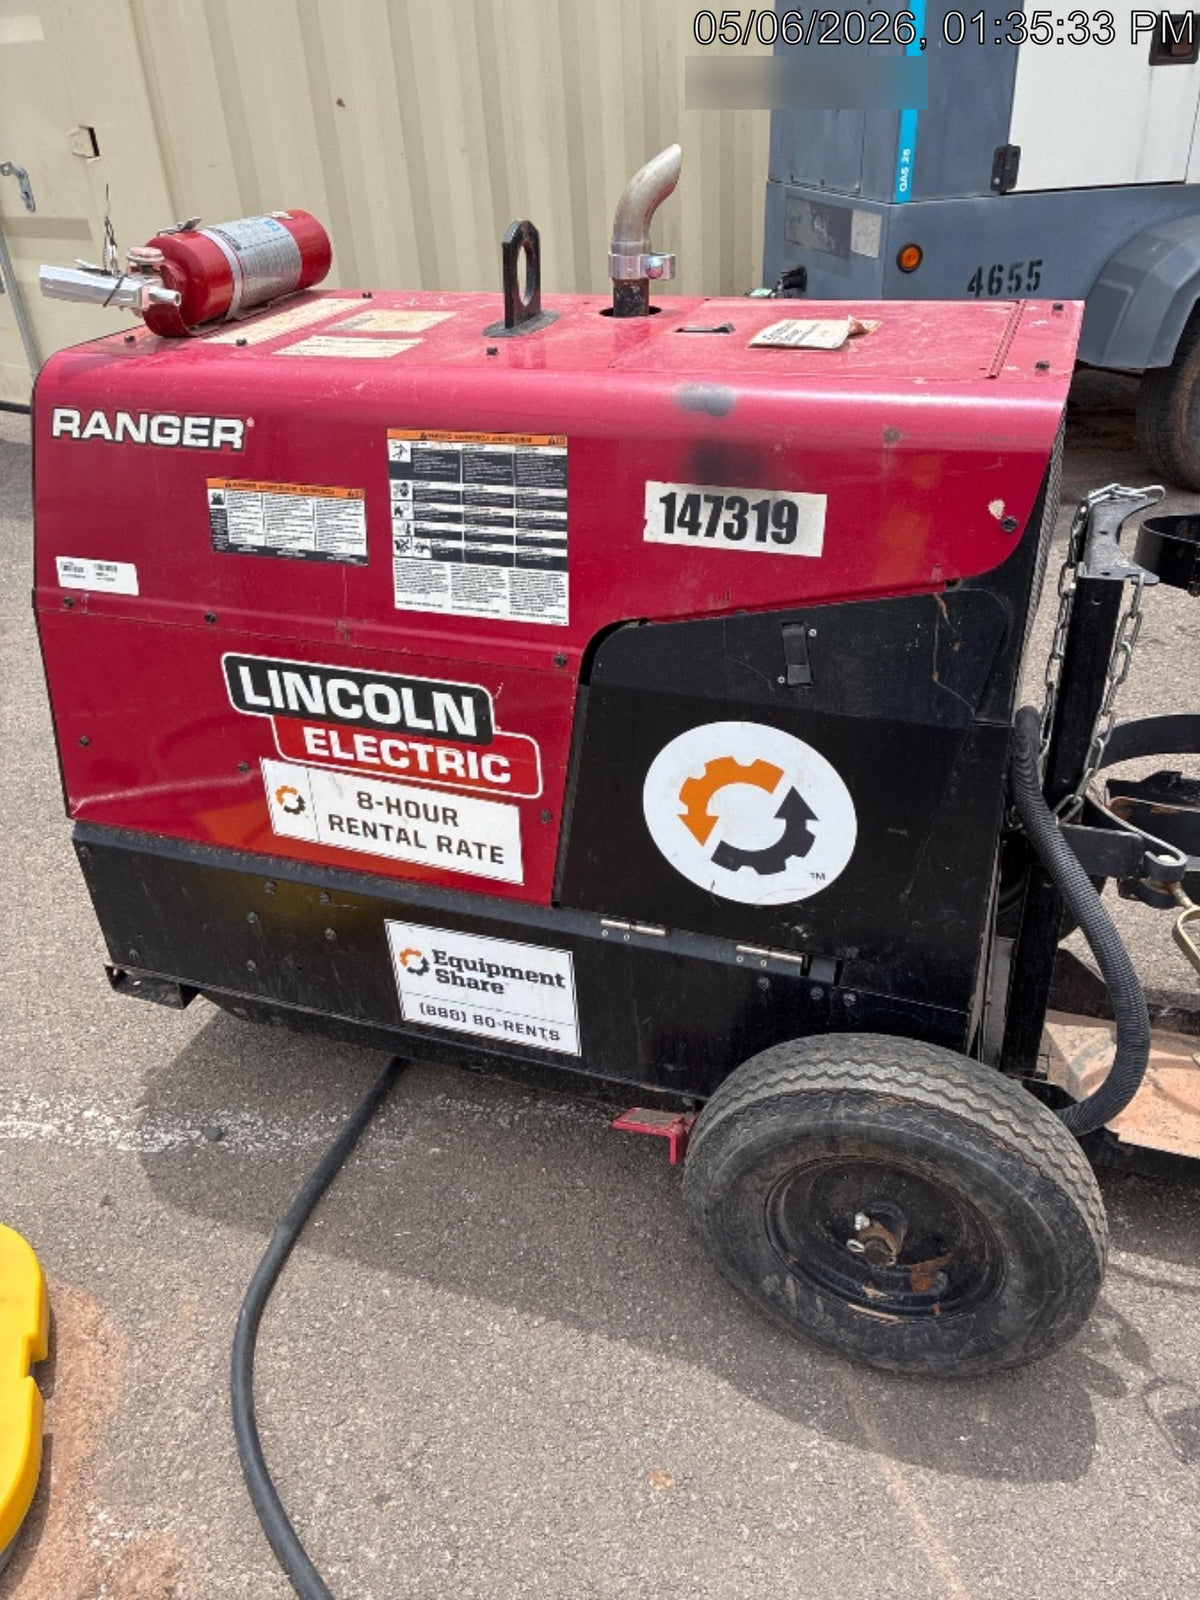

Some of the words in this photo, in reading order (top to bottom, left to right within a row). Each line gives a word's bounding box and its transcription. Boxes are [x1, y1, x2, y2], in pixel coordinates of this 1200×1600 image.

[967, 259, 1043, 298] 4655
[658, 491, 799, 545] 147319
[237, 665, 478, 737] LINCOLN
[302, 726, 511, 784] ELECTRIC
[356, 790, 459, 828] 8-HOUR
[328, 813, 427, 849] RENTAL
[436, 834, 505, 865] RATE
[431, 948, 566, 989] Equipment
[434, 968, 505, 995] Share
[418, 1002, 467, 1023] (888)
[472, 1014, 561, 1042] 80-RENTS
